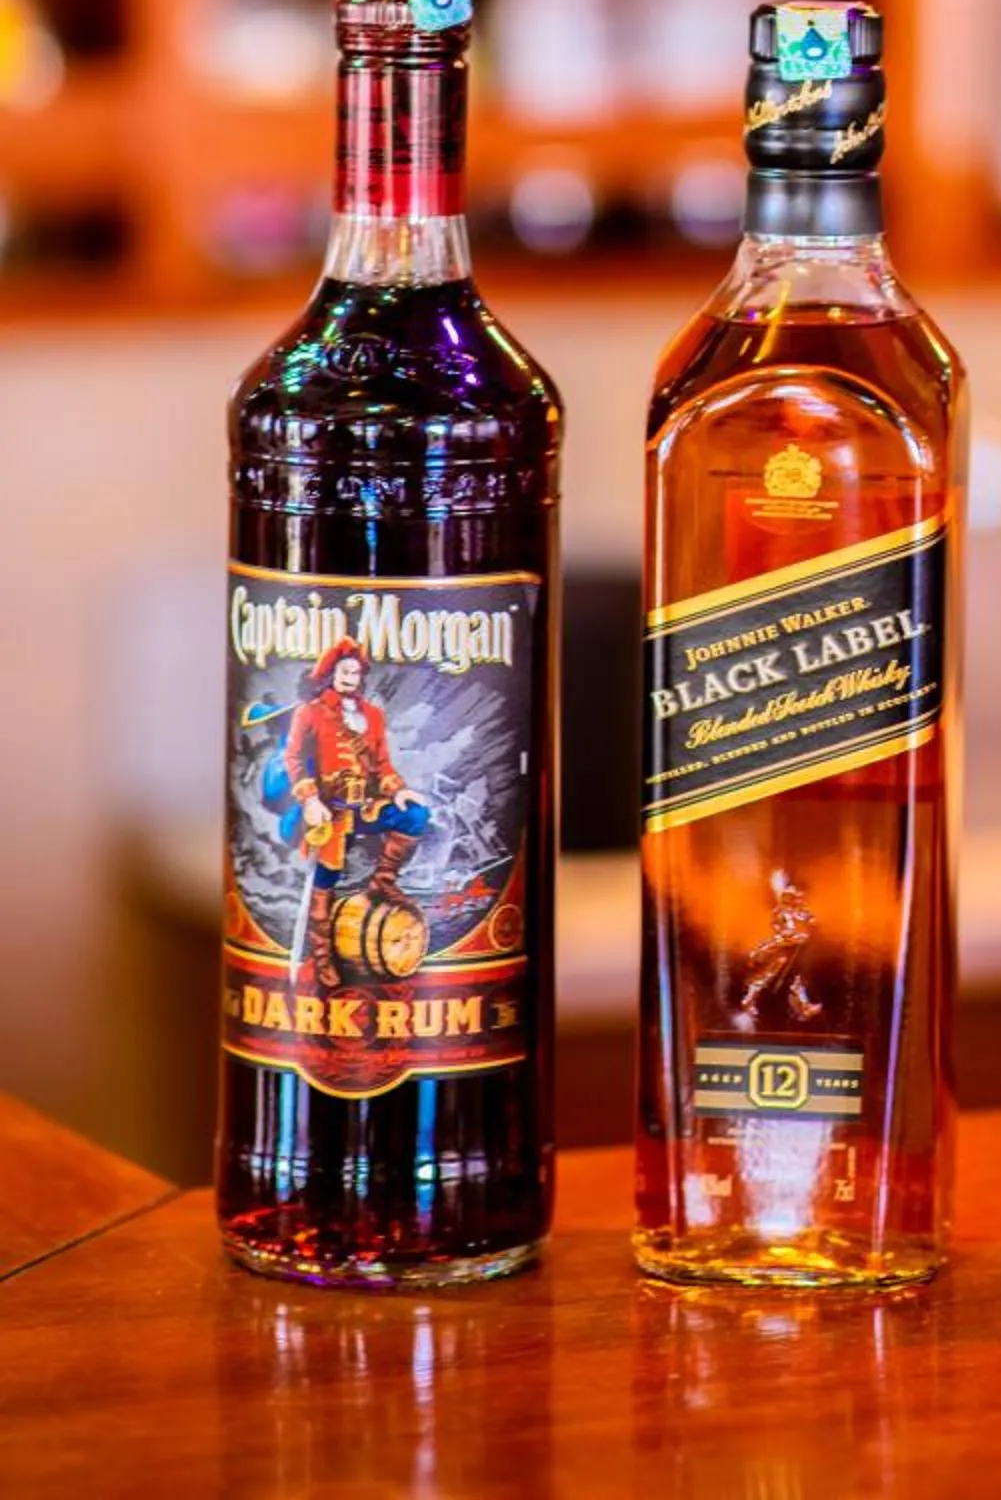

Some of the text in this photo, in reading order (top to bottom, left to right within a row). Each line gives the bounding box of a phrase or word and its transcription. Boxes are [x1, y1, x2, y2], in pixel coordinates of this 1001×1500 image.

[231, 586, 515, 675] Captain Morgan
[650, 608, 928, 720] BLACK LABEL
[684, 596, 870, 671] JOHNNIE WALKER
[684, 704, 776, 749] Blended
[829, 659, 912, 705] Whisky
[242, 985, 365, 1038] DARK
[375, 995, 484, 1039] RUM
[761, 1064, 798, 1097] 12
